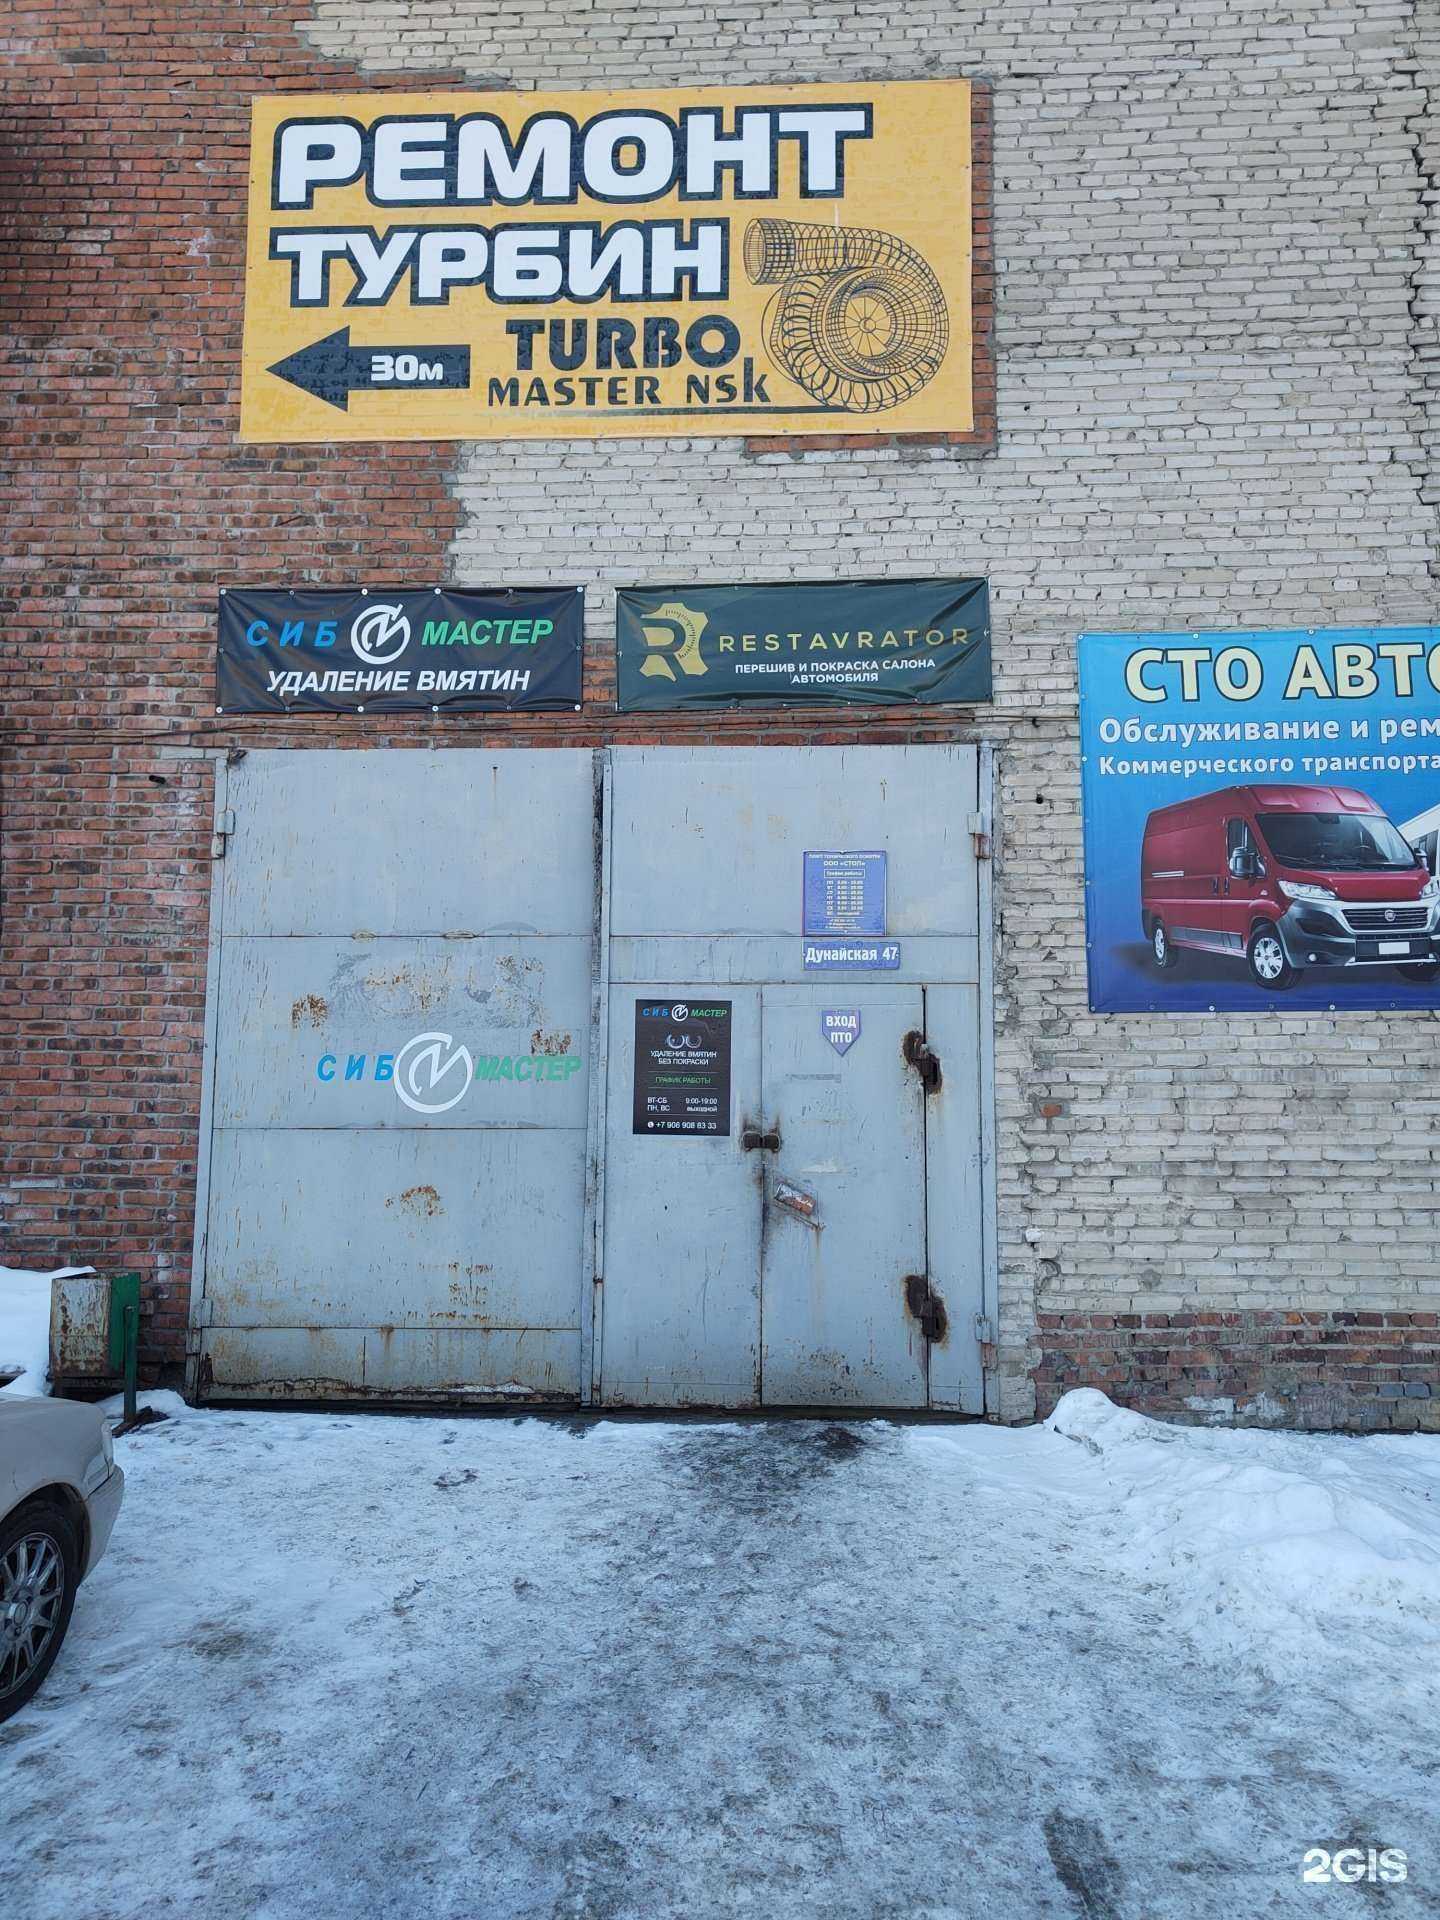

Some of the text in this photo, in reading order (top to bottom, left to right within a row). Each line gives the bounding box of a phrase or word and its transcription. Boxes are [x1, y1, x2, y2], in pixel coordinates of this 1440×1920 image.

[271, 103, 873, 209] РЕМОНТ
[269, 218, 730, 307] ТУРБИН
[505, 315, 741, 371] TURBO
[488, 376, 662, 407] MASTER
[421, 619, 554, 645] МАСТЕР
[719, 628, 968, 653] RESTAVRATOR
[735, 658, 936, 674] ПЕРЕШИВ И ПОКРАСКА САЛОНА
[791, 672, 879, 684] АВТОМОБИЛЯ
[1125, 647, 1264, 703] СТО
[267, 670, 531, 696] УДАЛЕНИЕ ВМЯТИН
[1099, 717, 1340, 747] Обслуживание
[1351, 721, 1369, 739] и
[1099, 756, 1294, 777] Коммерческого
[806, 947, 898, 963] Дунайская 47
[691, 1009, 727, 1017] МАСТЕР
[826, 1015, 856, 1028] ВХОД
[830, 1031, 852, 1042] ПТО
[475, 1056, 582, 1081] МАСТЕР
